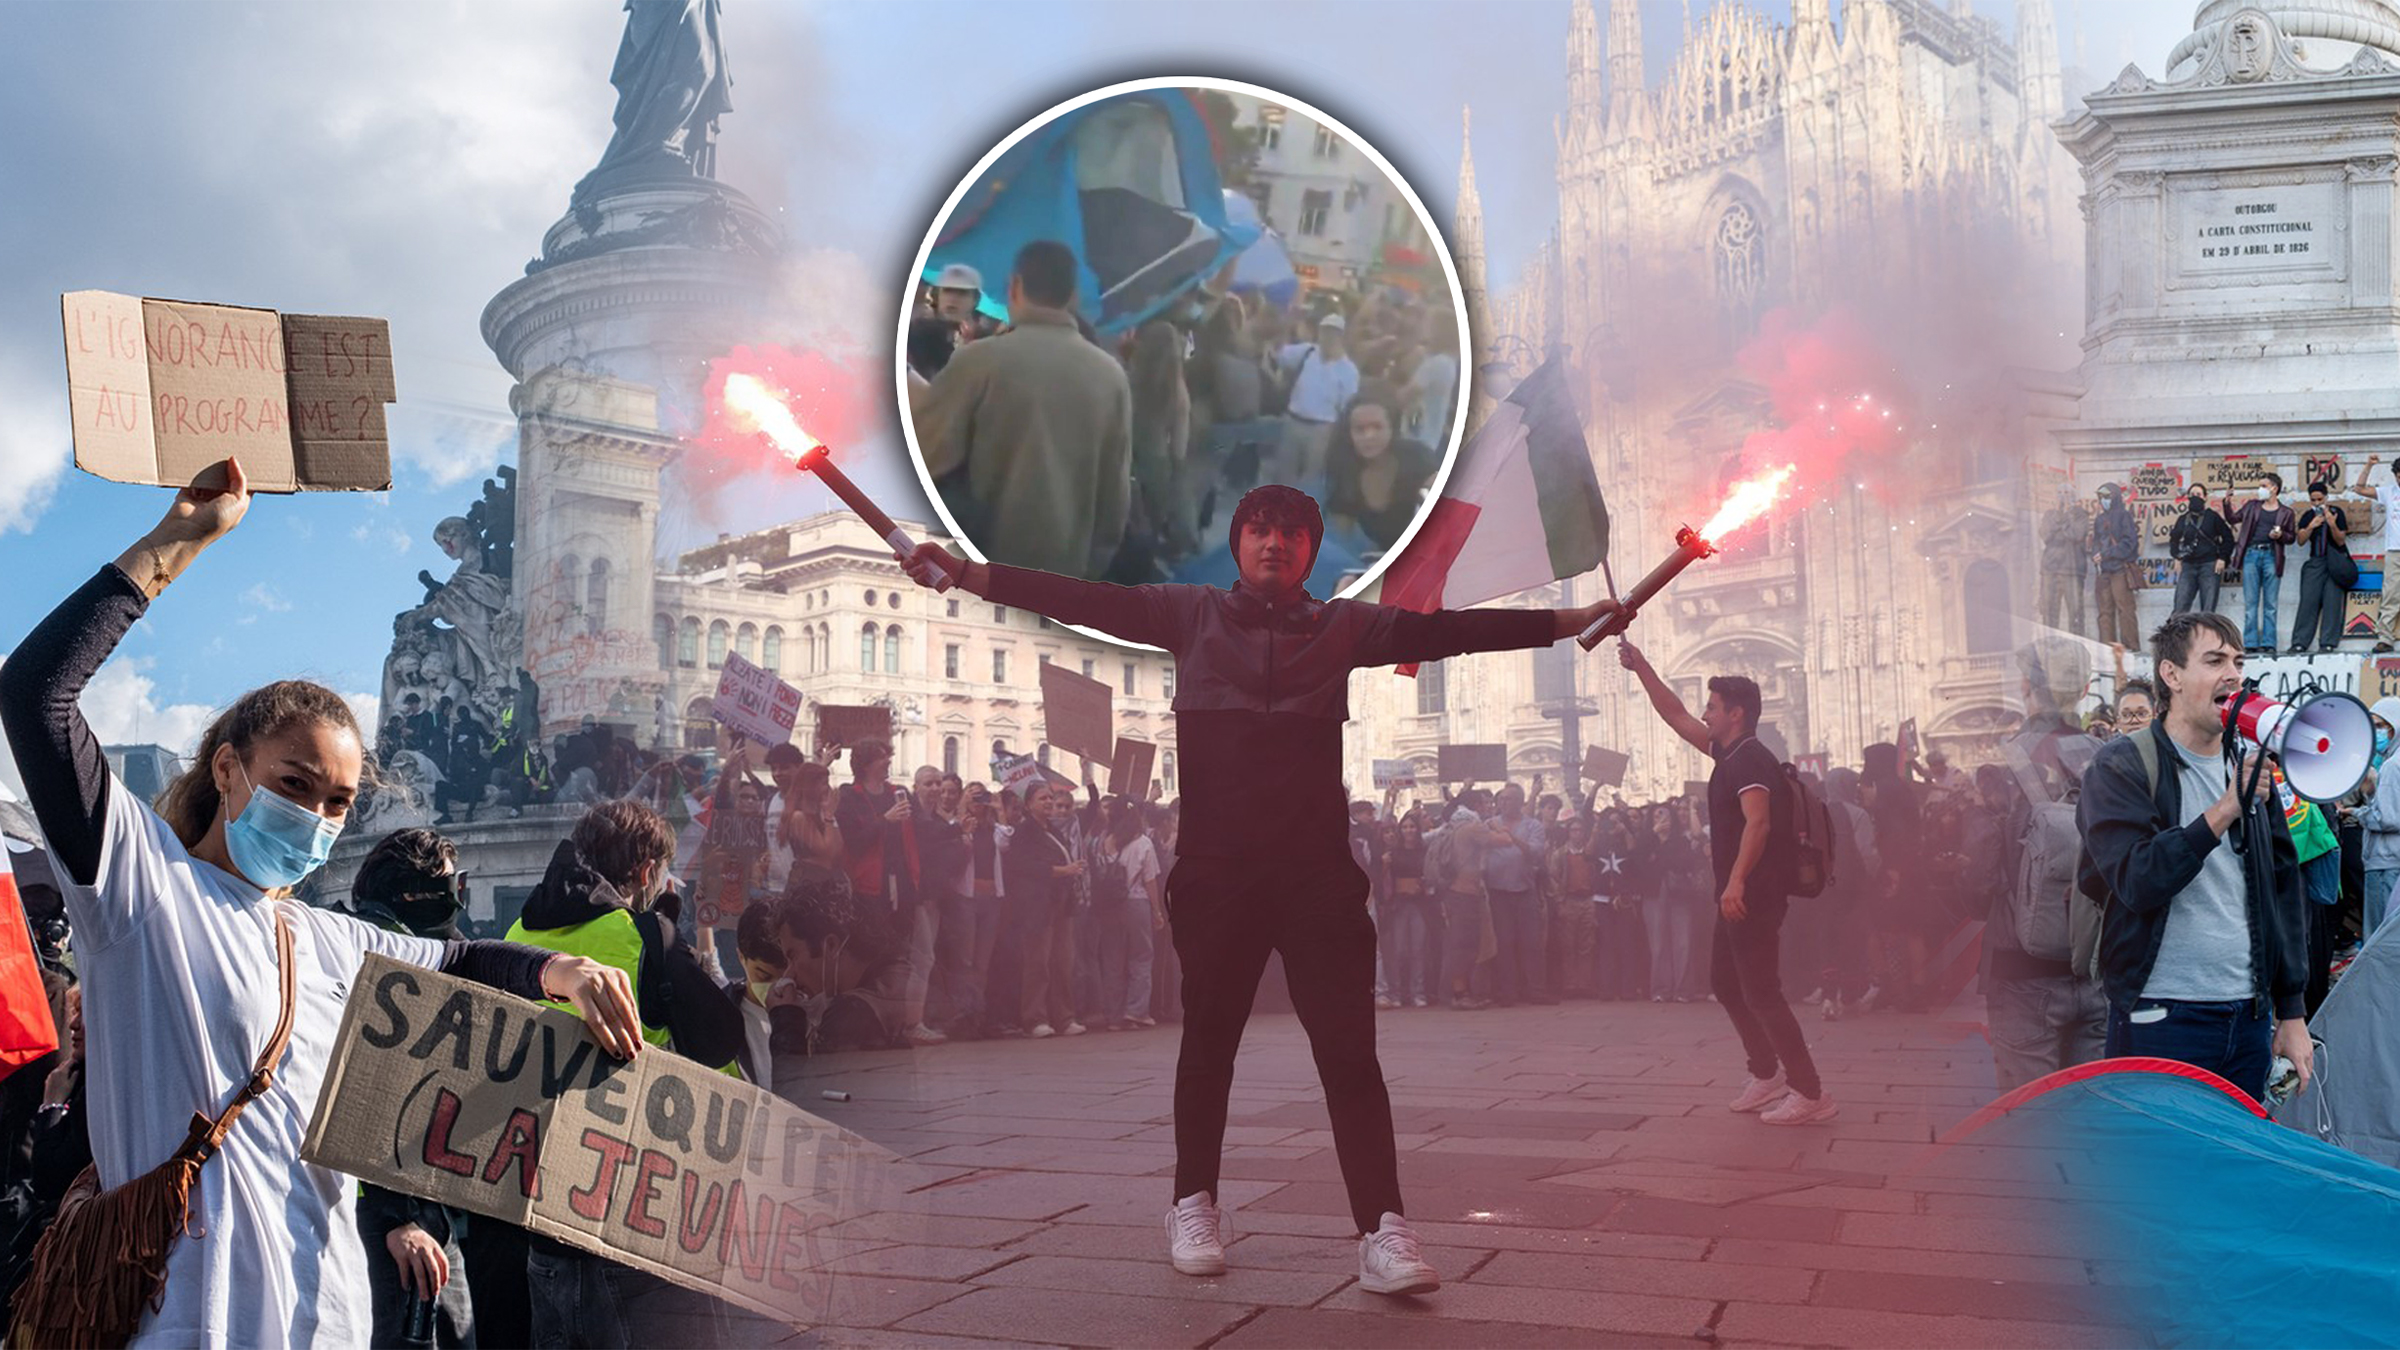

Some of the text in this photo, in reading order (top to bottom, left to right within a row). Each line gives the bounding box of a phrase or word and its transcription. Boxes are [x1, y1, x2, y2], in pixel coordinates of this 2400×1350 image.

[2235, 203, 2278, 215] OUTORGOU
[2198, 221, 2313, 238] A CARTA CONSTITUCIONAL
[2202, 248, 2215, 258] EM
[2274, 243, 2286, 253] DE
[2289, 242, 2309, 253] 1826
[323, 332, 379, 378] EST
[96, 384, 137, 433] AU
[2138, 486, 2168, 496] TUDO
[361, 972, 636, 1125] SAUVE
